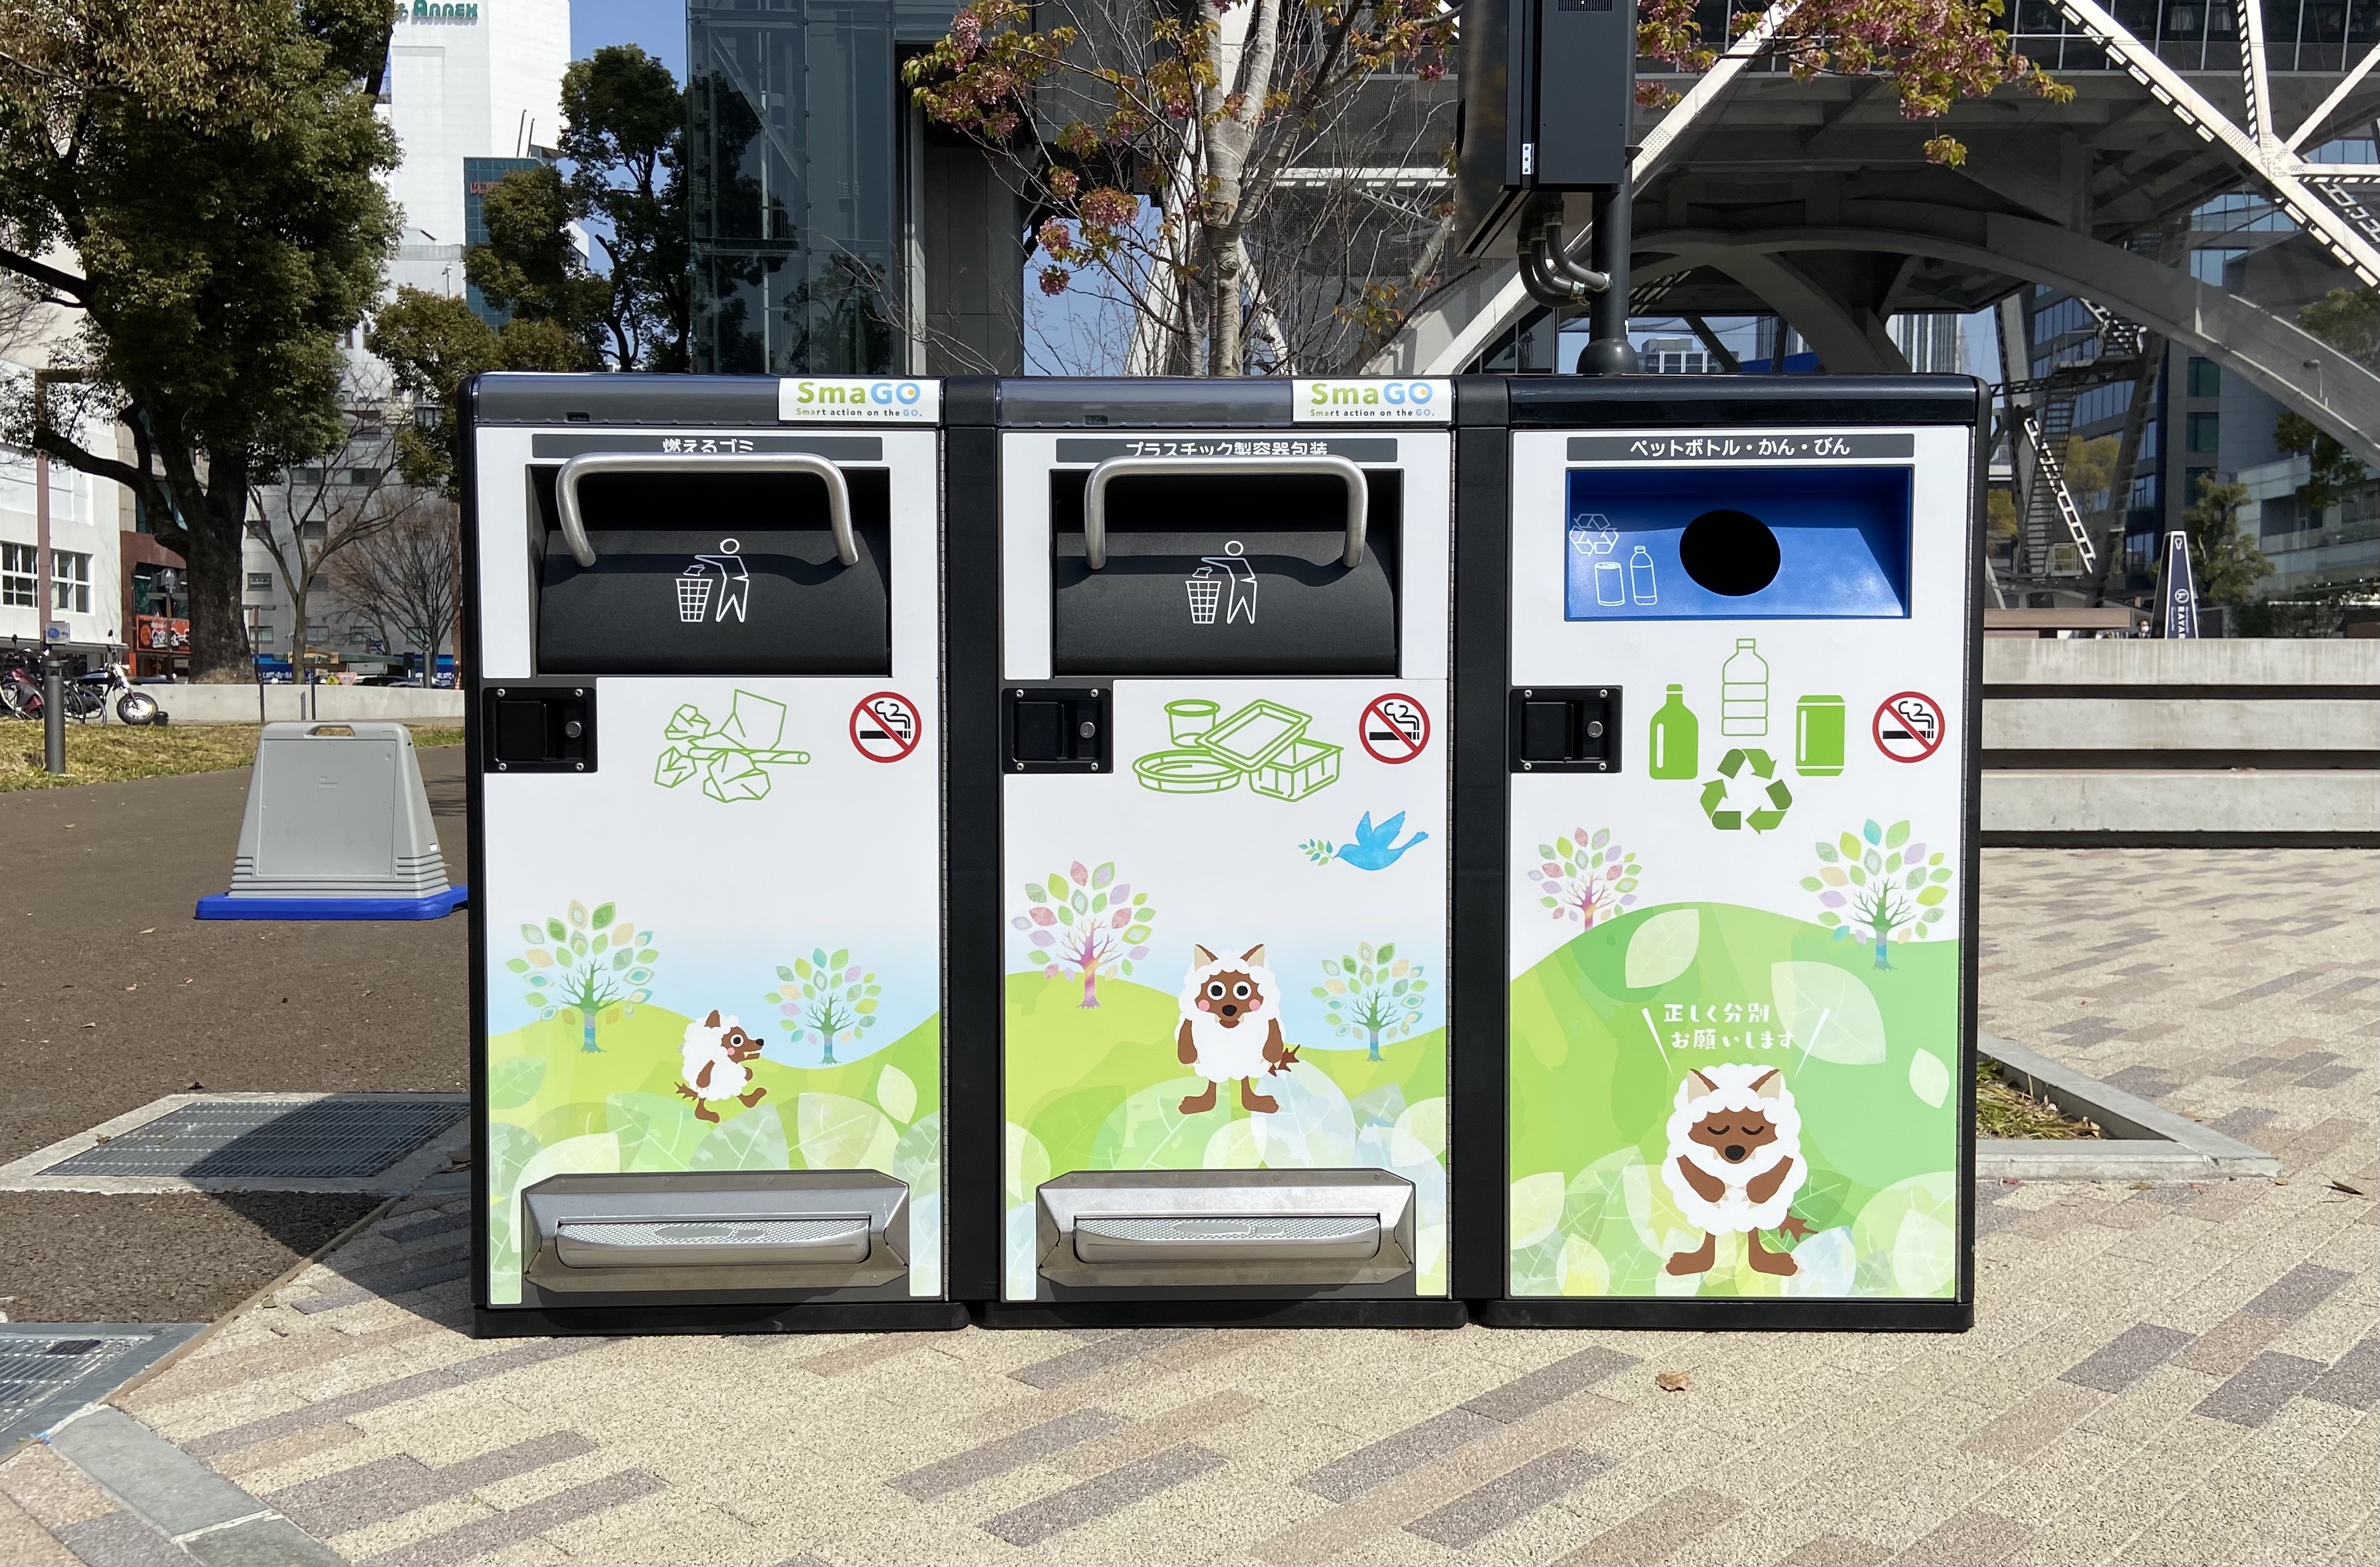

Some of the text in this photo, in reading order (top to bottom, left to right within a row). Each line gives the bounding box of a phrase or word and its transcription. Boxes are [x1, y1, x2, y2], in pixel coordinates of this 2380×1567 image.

[797, 381, 920, 405] SmaGO
[1311, 382, 1433, 405] SmaGO
[797, 407, 826, 416] Smart
[830, 408, 862, 416] action
[903, 409, 922, 417] GO.
[1126, 441, 1328, 456] プラスチック製容器包装
[1630, 437, 1850, 457] ペットボトル・かん・びん
[1664, 1002, 1770, 1023] 正しく分別
[1671, 1028, 1796, 1050] お願いします
